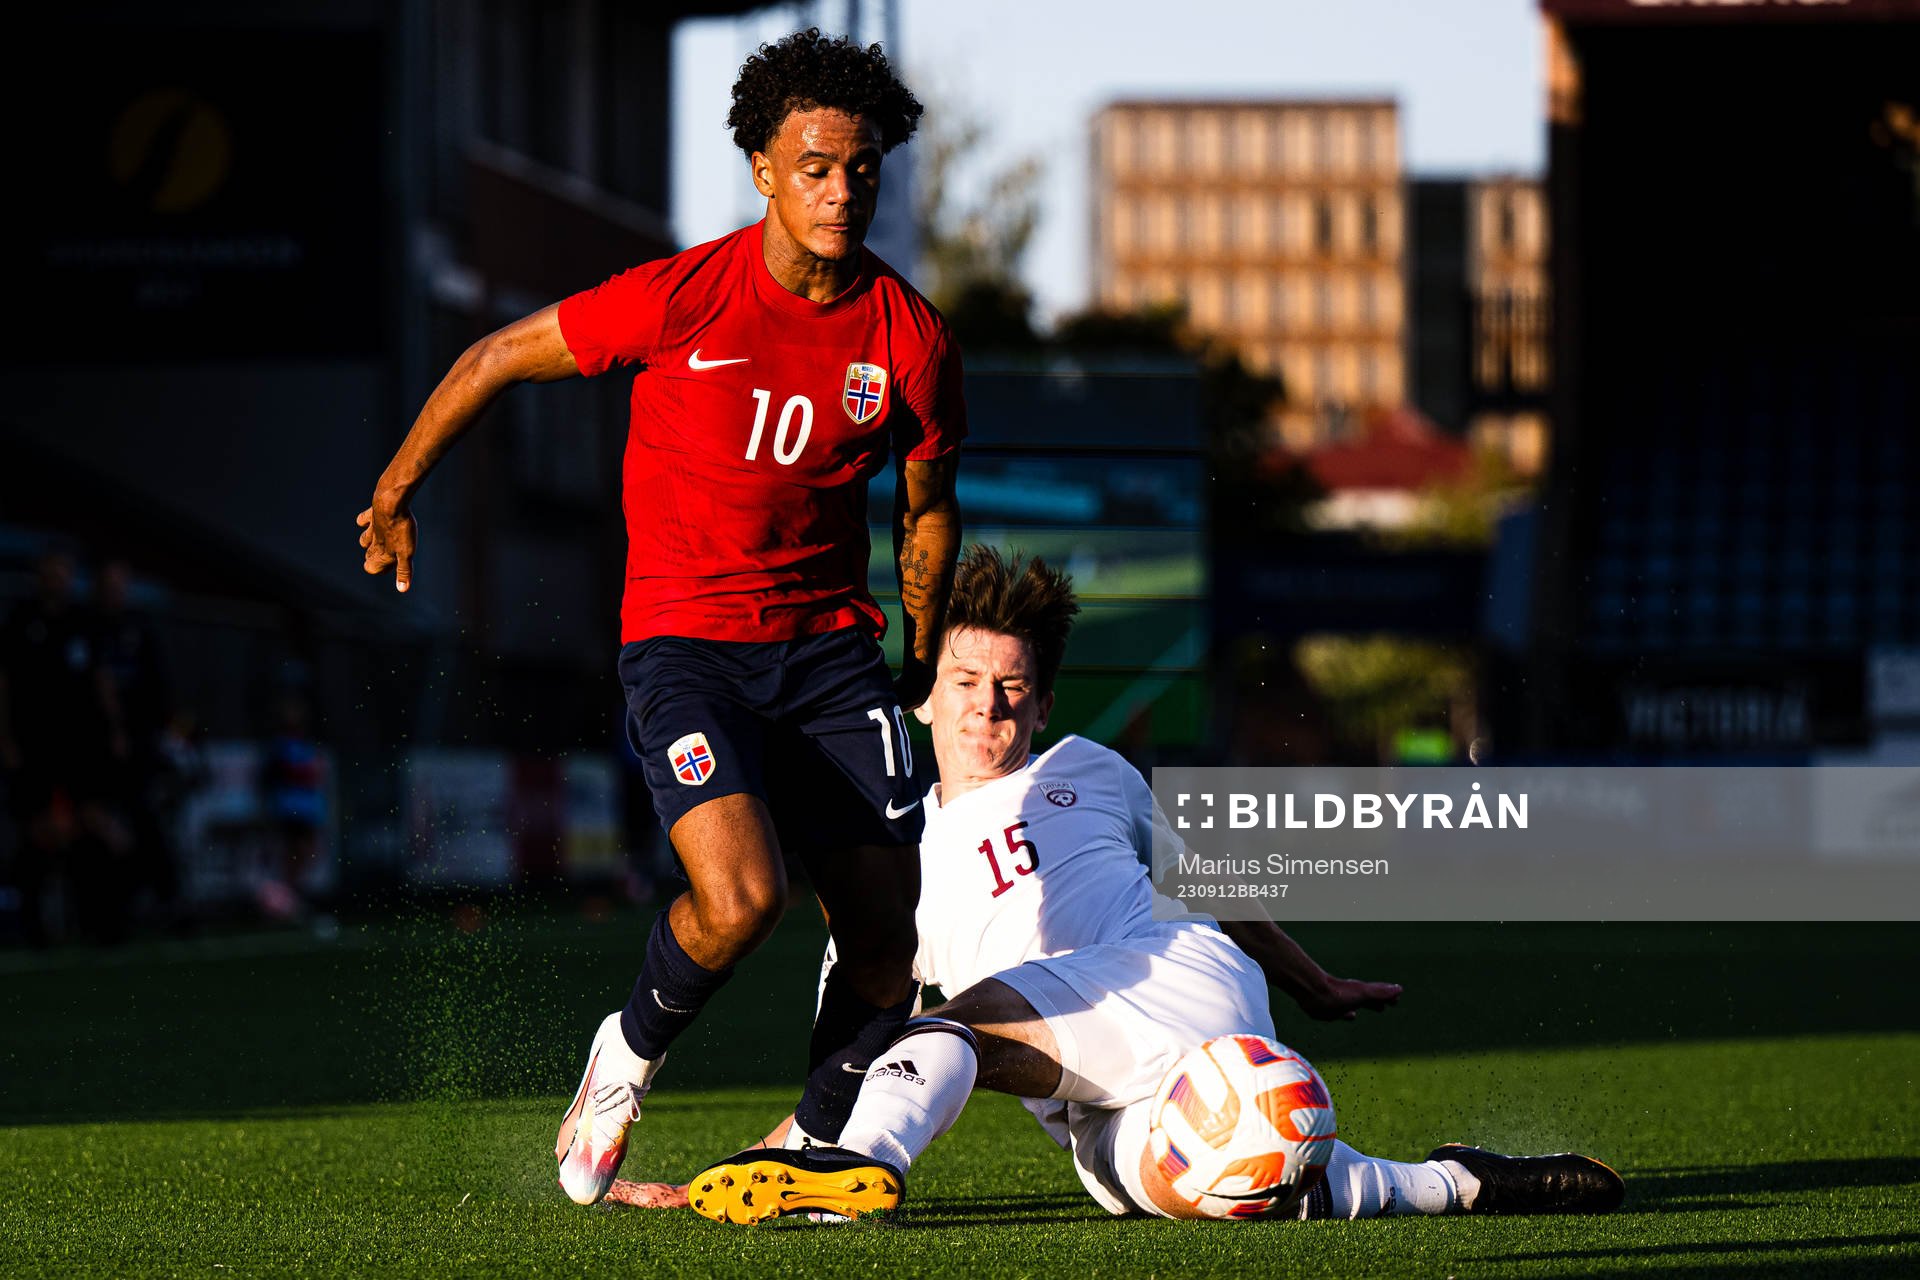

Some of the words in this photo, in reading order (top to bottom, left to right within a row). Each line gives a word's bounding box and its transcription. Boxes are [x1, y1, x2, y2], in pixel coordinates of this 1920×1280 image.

[745, 388, 814, 466] 10
[866, 705, 913, 779] 10
[977, 820, 1040, 899] 15
[866, 1067, 926, 1086] adidas
